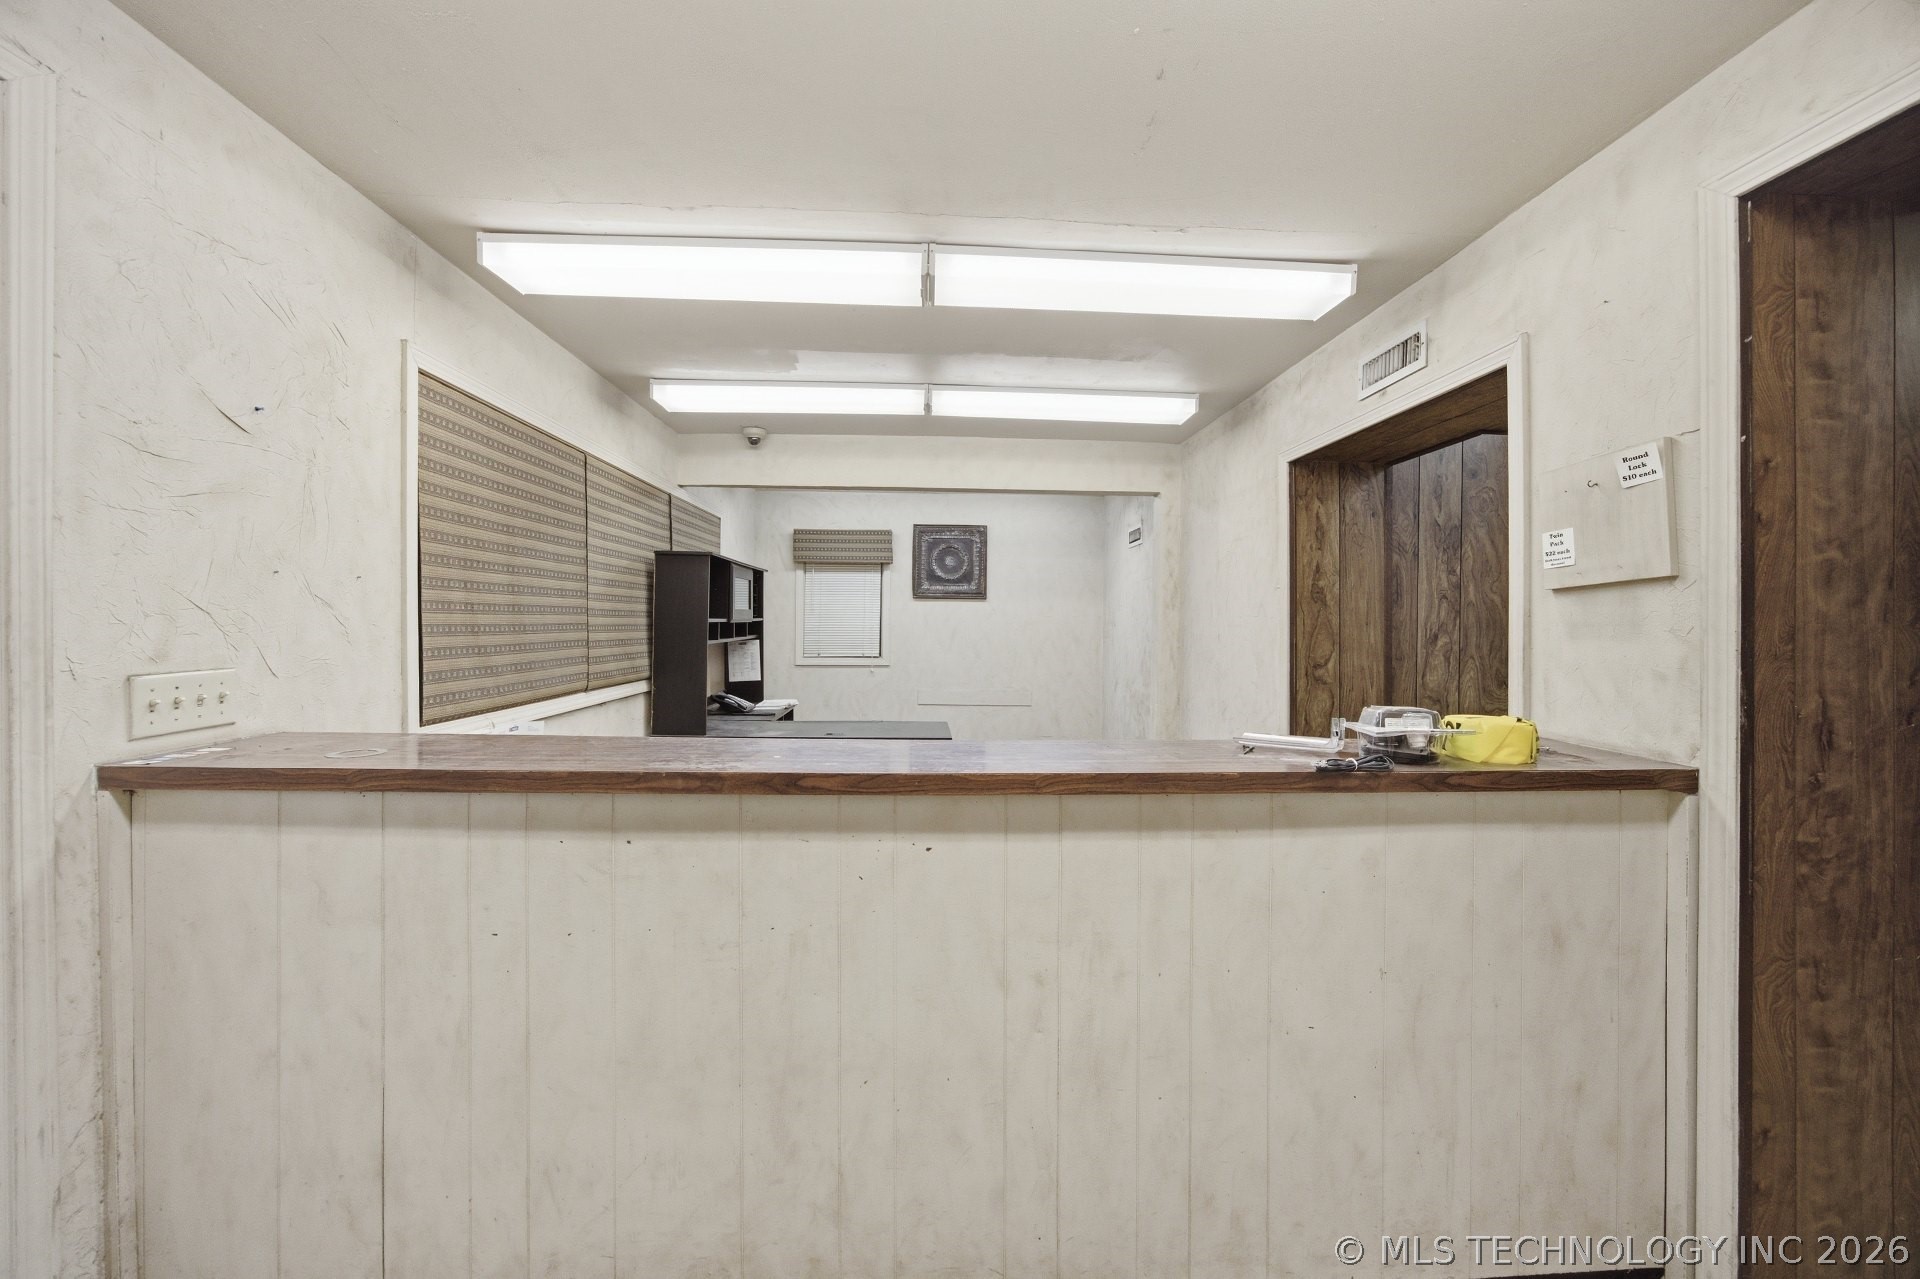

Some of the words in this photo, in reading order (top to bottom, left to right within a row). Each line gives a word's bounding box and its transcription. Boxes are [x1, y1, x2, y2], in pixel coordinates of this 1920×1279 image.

[1622, 451, 1649, 463] Round
[1628, 461, 1648, 471] Lock
[1622, 473, 1637, 482] $10
[1638, 468, 1657, 478] each
